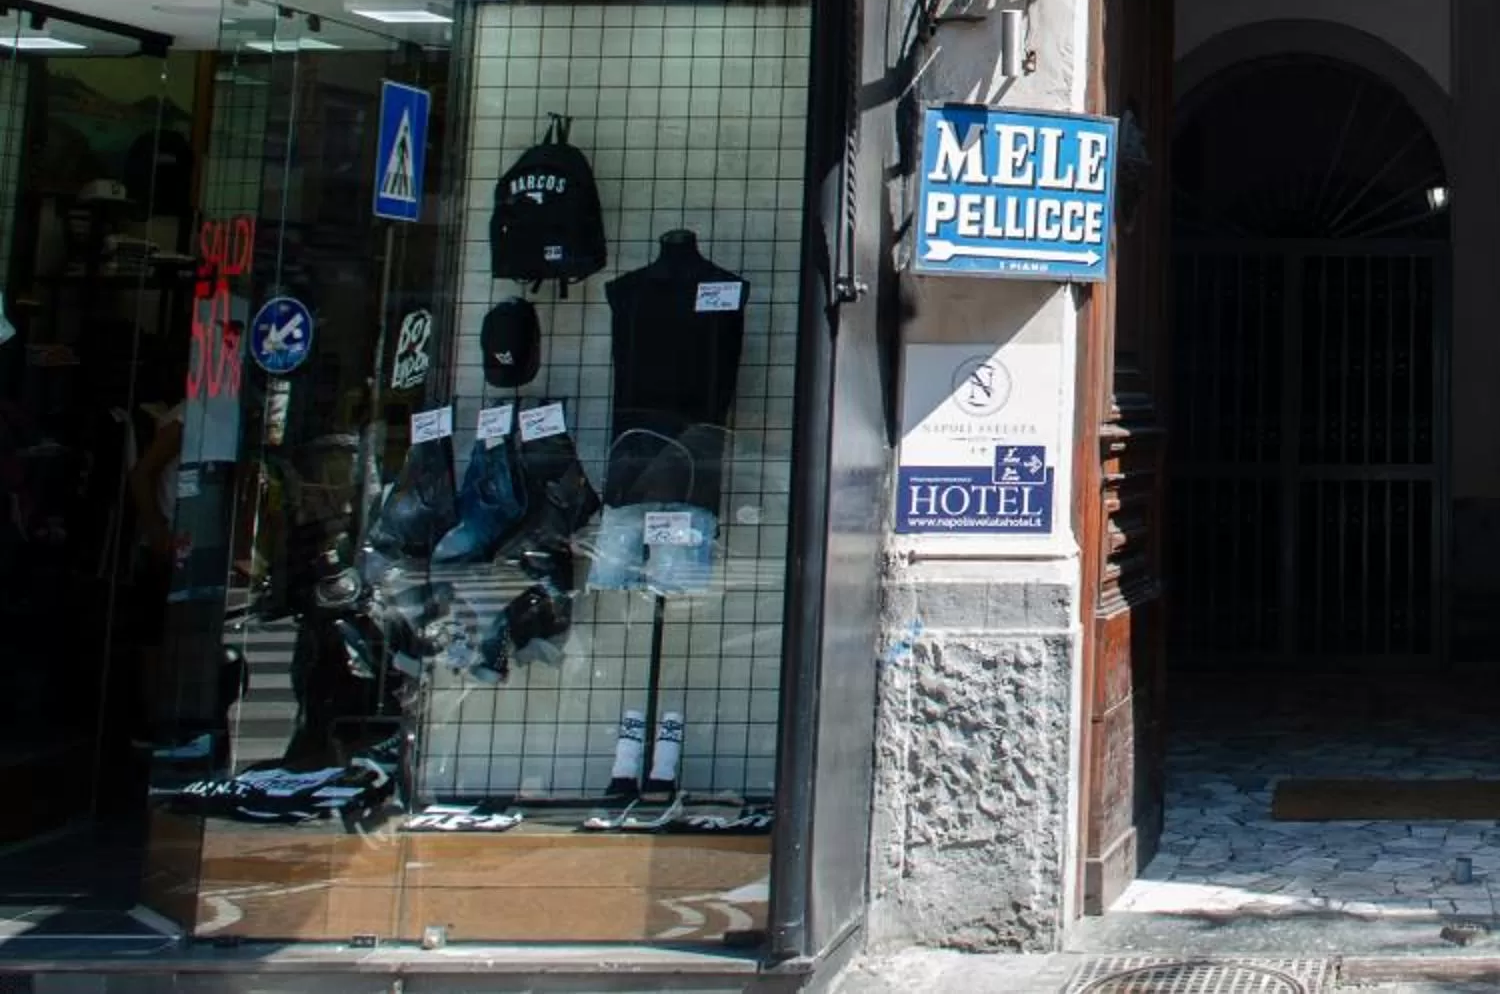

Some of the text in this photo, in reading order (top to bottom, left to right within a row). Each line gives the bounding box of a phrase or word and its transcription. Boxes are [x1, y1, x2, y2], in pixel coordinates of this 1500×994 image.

[927, 120, 1109, 193] MELE
[509, 174, 567, 195] NARCOS
[924, 191, 1104, 244] PELLICCE
[1009, 261, 1049, 271] PIANO
[908, 484, 1044, 517] HOTEL
